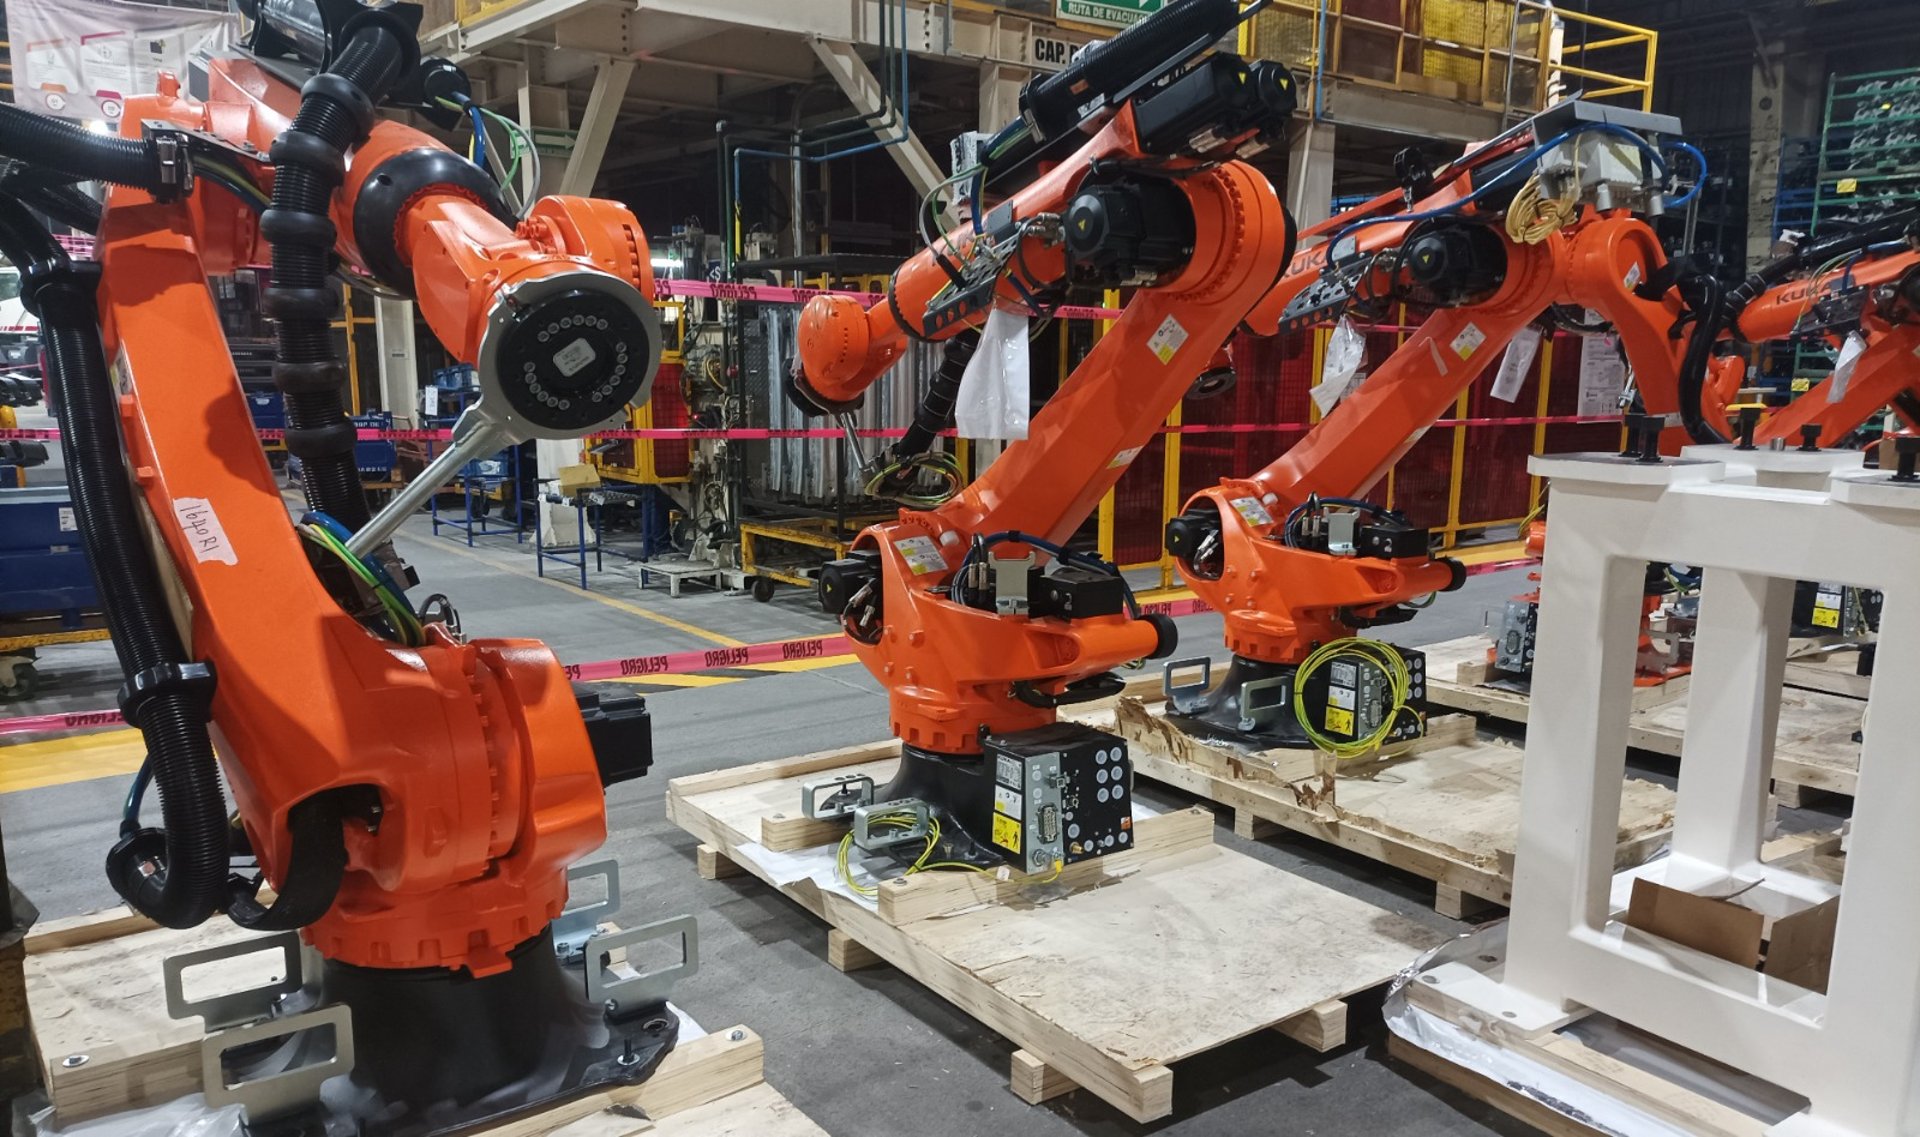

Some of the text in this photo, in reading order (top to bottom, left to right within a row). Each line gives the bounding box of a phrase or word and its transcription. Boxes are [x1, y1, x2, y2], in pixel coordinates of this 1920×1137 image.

[1068, 2, 1091, 16] RUTA
[1092, 6, 1105, 18] DE
[1035, 38, 1066, 64] CAP.
